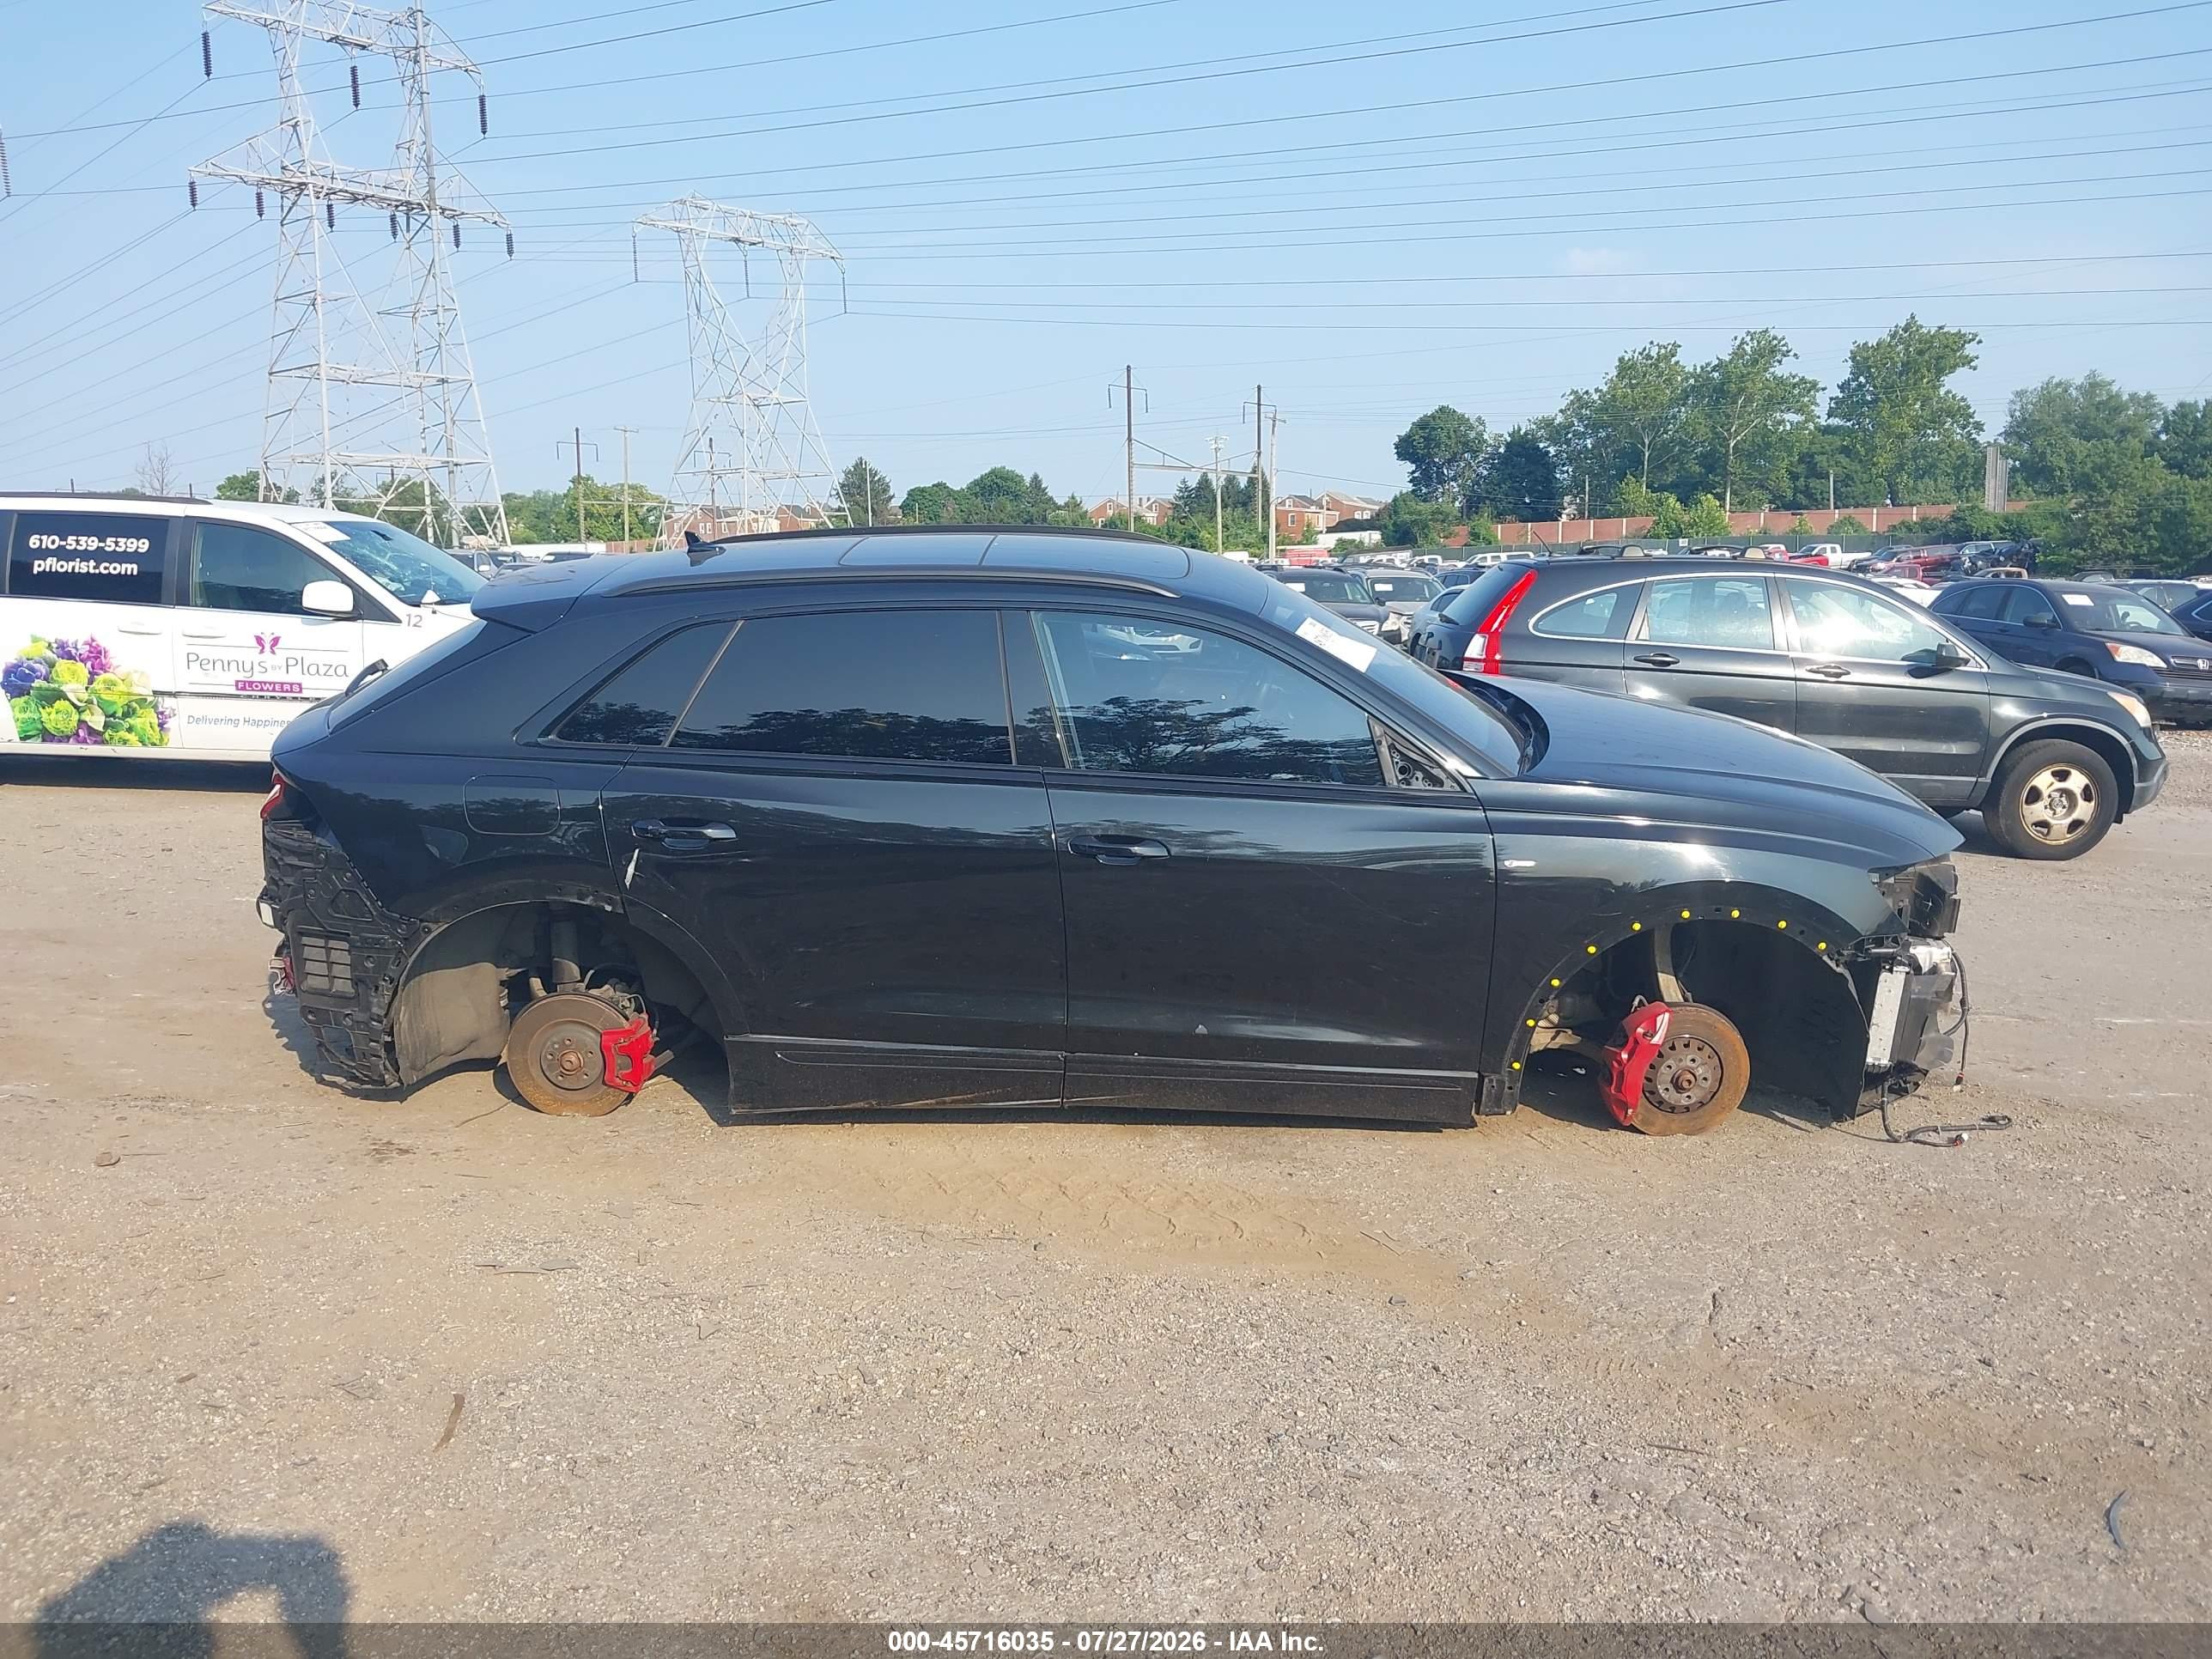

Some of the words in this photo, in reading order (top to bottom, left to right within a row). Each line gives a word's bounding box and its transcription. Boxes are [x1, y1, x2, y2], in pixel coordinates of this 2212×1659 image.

[28, 534, 150, 553] 610-539-5399
[33, 556, 138, 575] pflorist.com
[405, 613, 422, 628] 12
[186, 652, 268, 679] Pennys
[285, 656, 349, 678] Plaza
[238, 682, 301, 692] FLOWERS
[187, 714, 240, 727] Delivering
